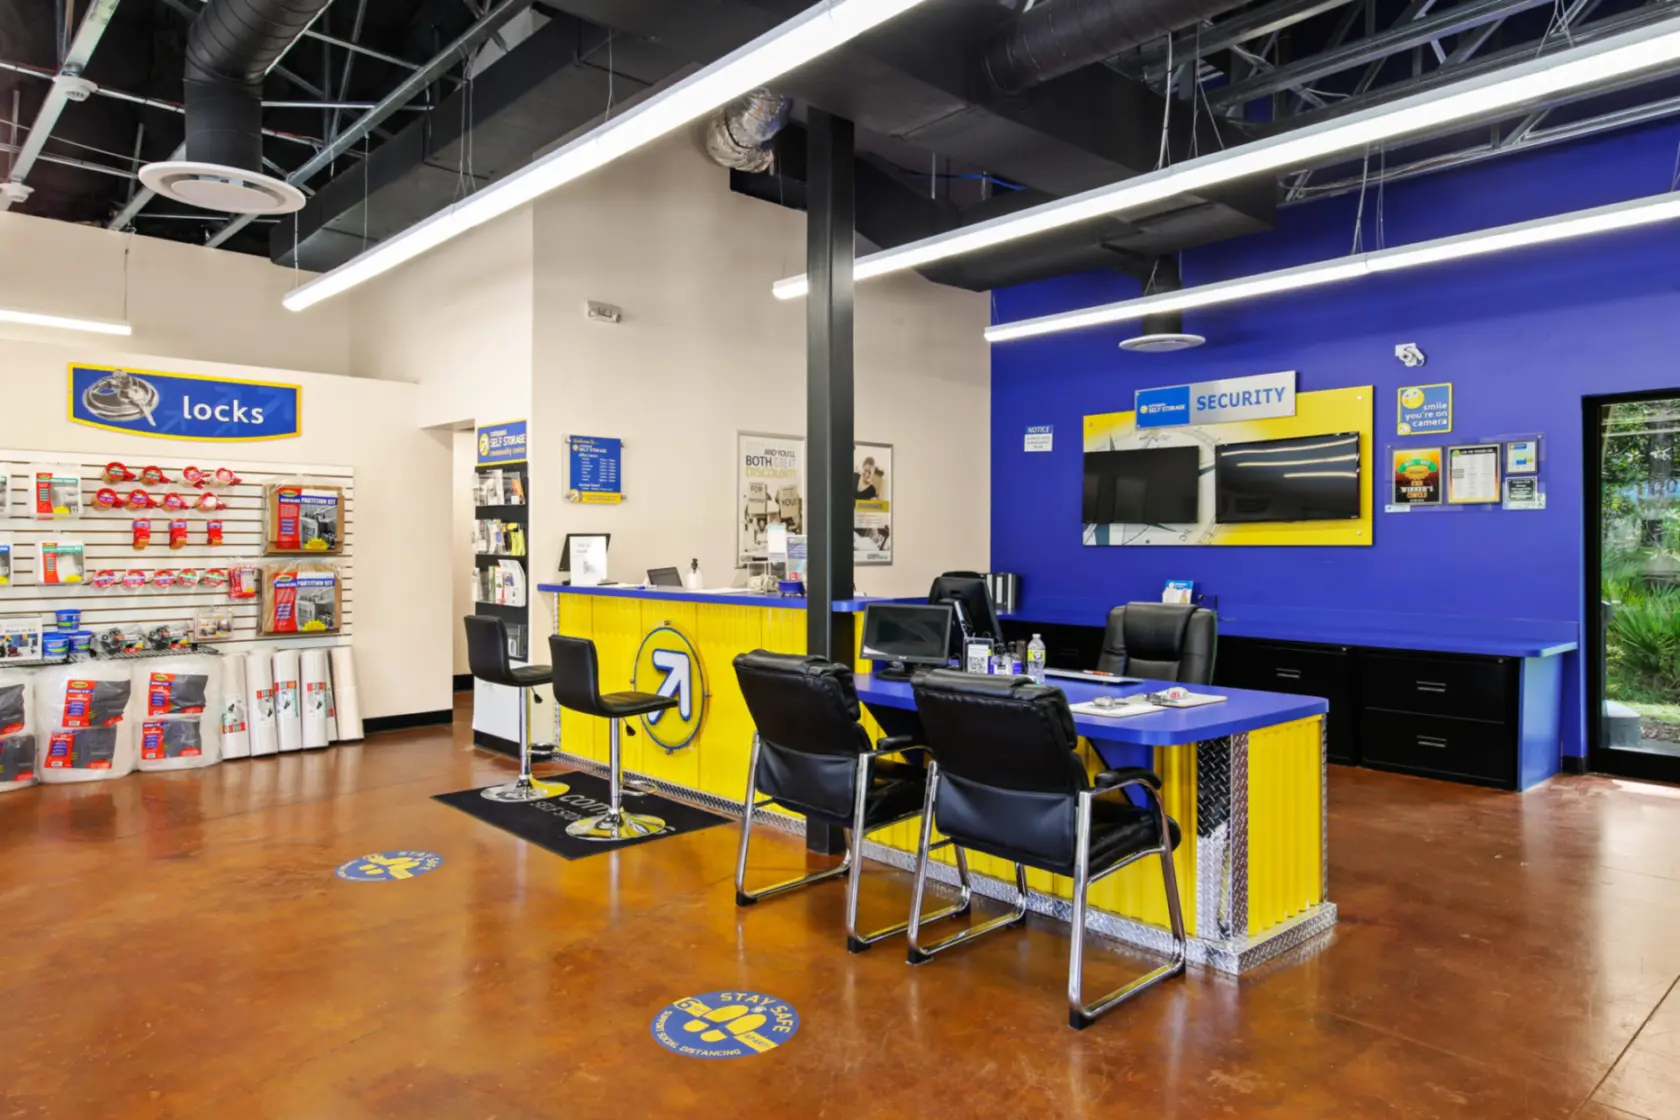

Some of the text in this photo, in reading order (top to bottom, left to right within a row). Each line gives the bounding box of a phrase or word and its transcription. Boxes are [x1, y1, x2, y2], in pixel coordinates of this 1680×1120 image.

[1196, 386, 1286, 411] SECURITY
[183, 395, 264, 424] locks
[1423, 402, 1448, 410] smile
[1405, 412, 1434, 421] you're
[1412, 419, 1447, 427] camera
[490, 436, 503, 448] SELF
[503, 433, 527, 446] STORAGE
[764, 448, 777, 456] AND
[745, 455, 772, 467] BOTH
[720, 992, 794, 1034] STAY SAFE
[679, 1046, 741, 1056] DISTANCING
